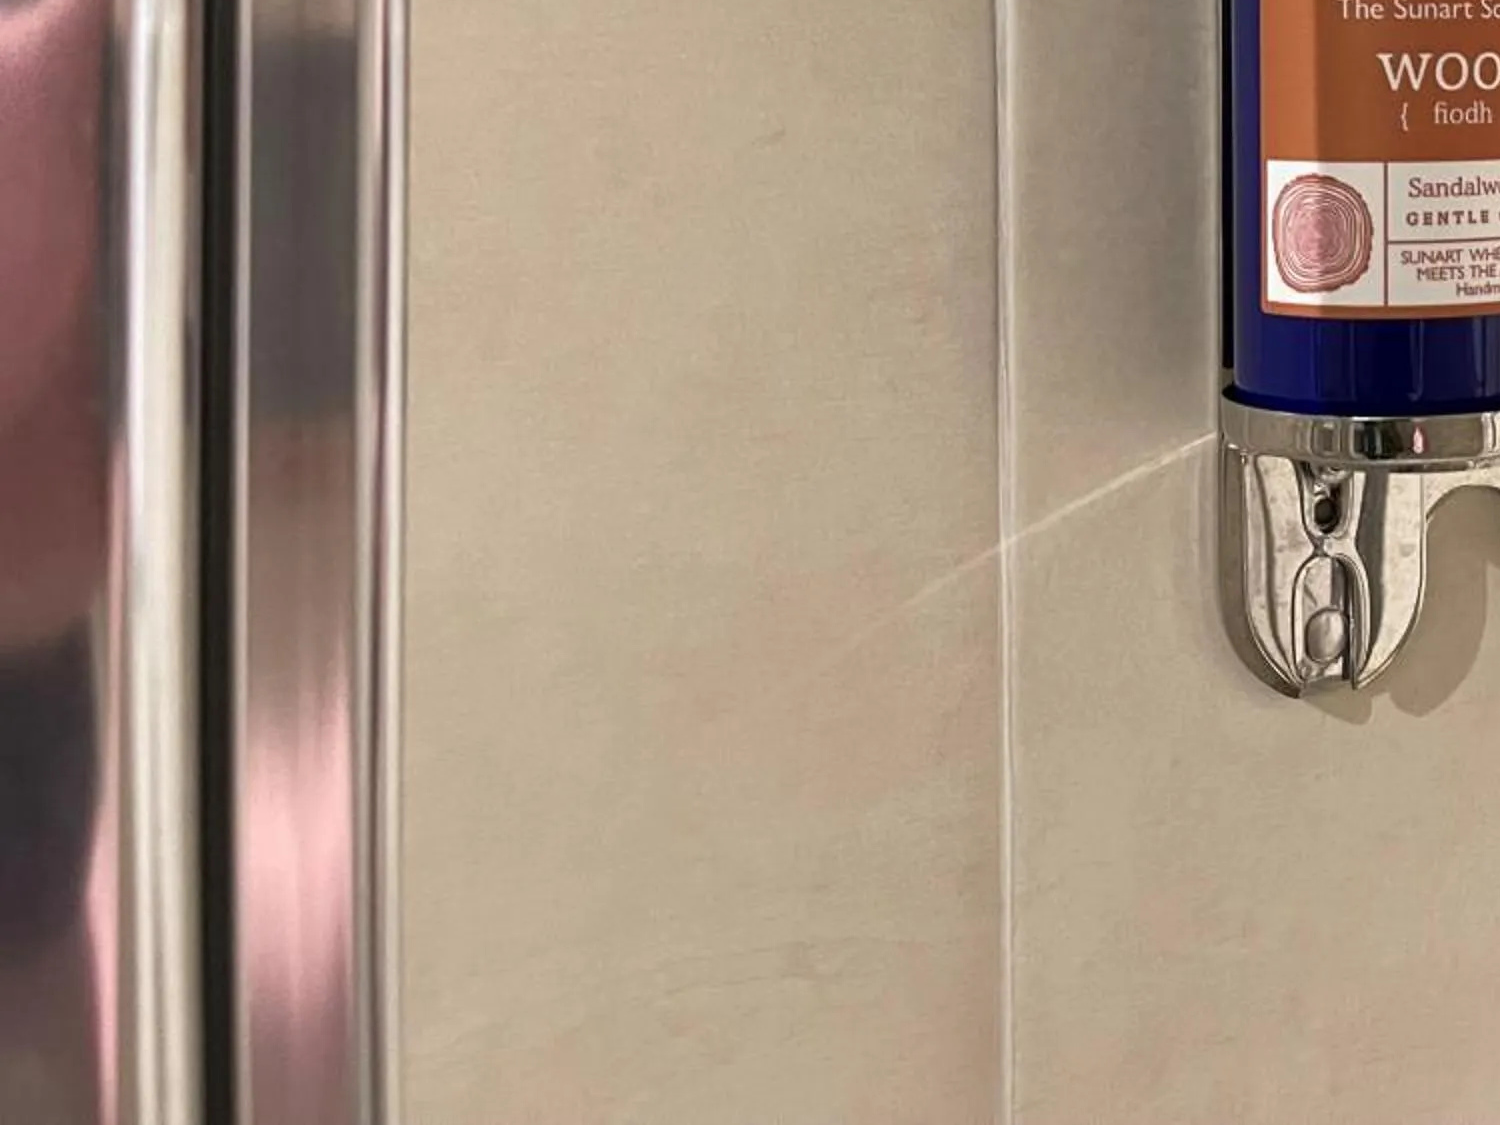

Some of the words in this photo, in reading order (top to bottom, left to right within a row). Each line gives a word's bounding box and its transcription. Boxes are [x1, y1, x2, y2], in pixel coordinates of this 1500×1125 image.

[1434, 100, 1493, 125] fiodh
[1406, 209, 1489, 226] GENTLE
[1401, 248, 1464, 265] SUNART
[1416, 265, 1465, 282] MEETS
[1470, 263, 1498, 279] THE
